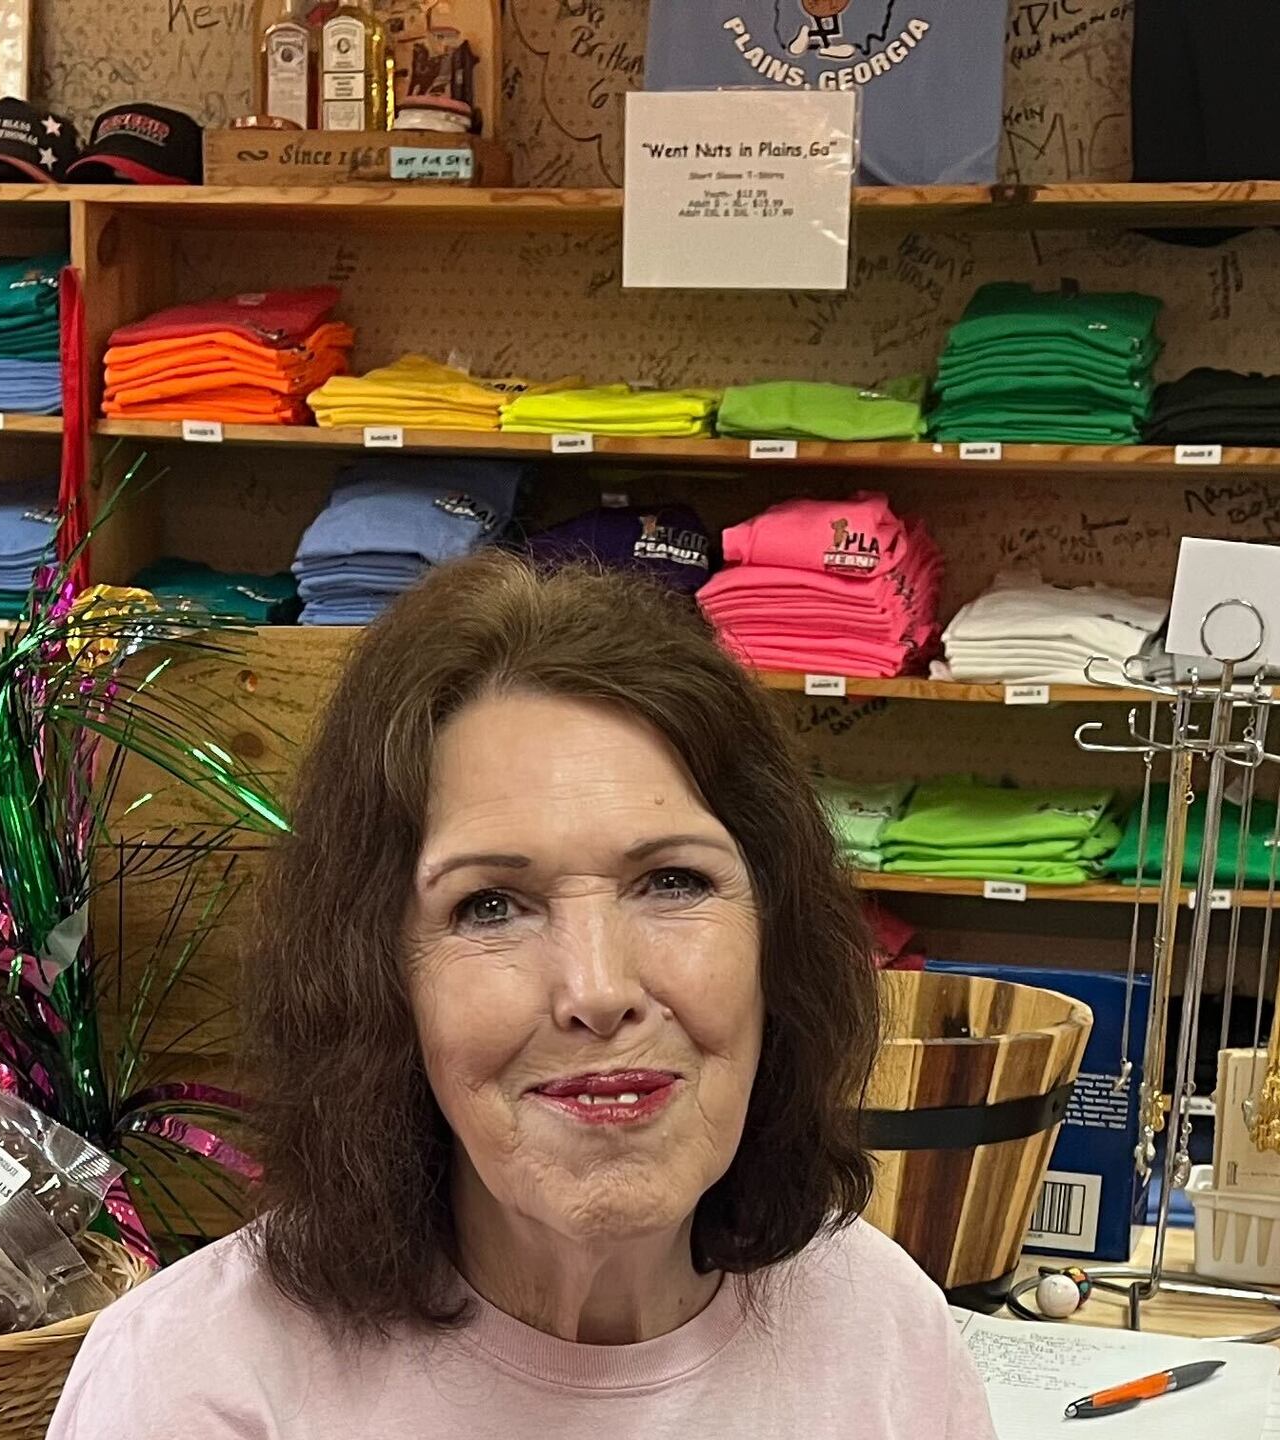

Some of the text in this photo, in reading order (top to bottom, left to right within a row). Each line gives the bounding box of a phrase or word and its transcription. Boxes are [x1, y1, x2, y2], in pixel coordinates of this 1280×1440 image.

[819, 18, 931, 91] GEORGIA
[279, 143, 332, 166] Since
[695, 143, 732, 158] Nuts
[738, 142, 753, 158] in
